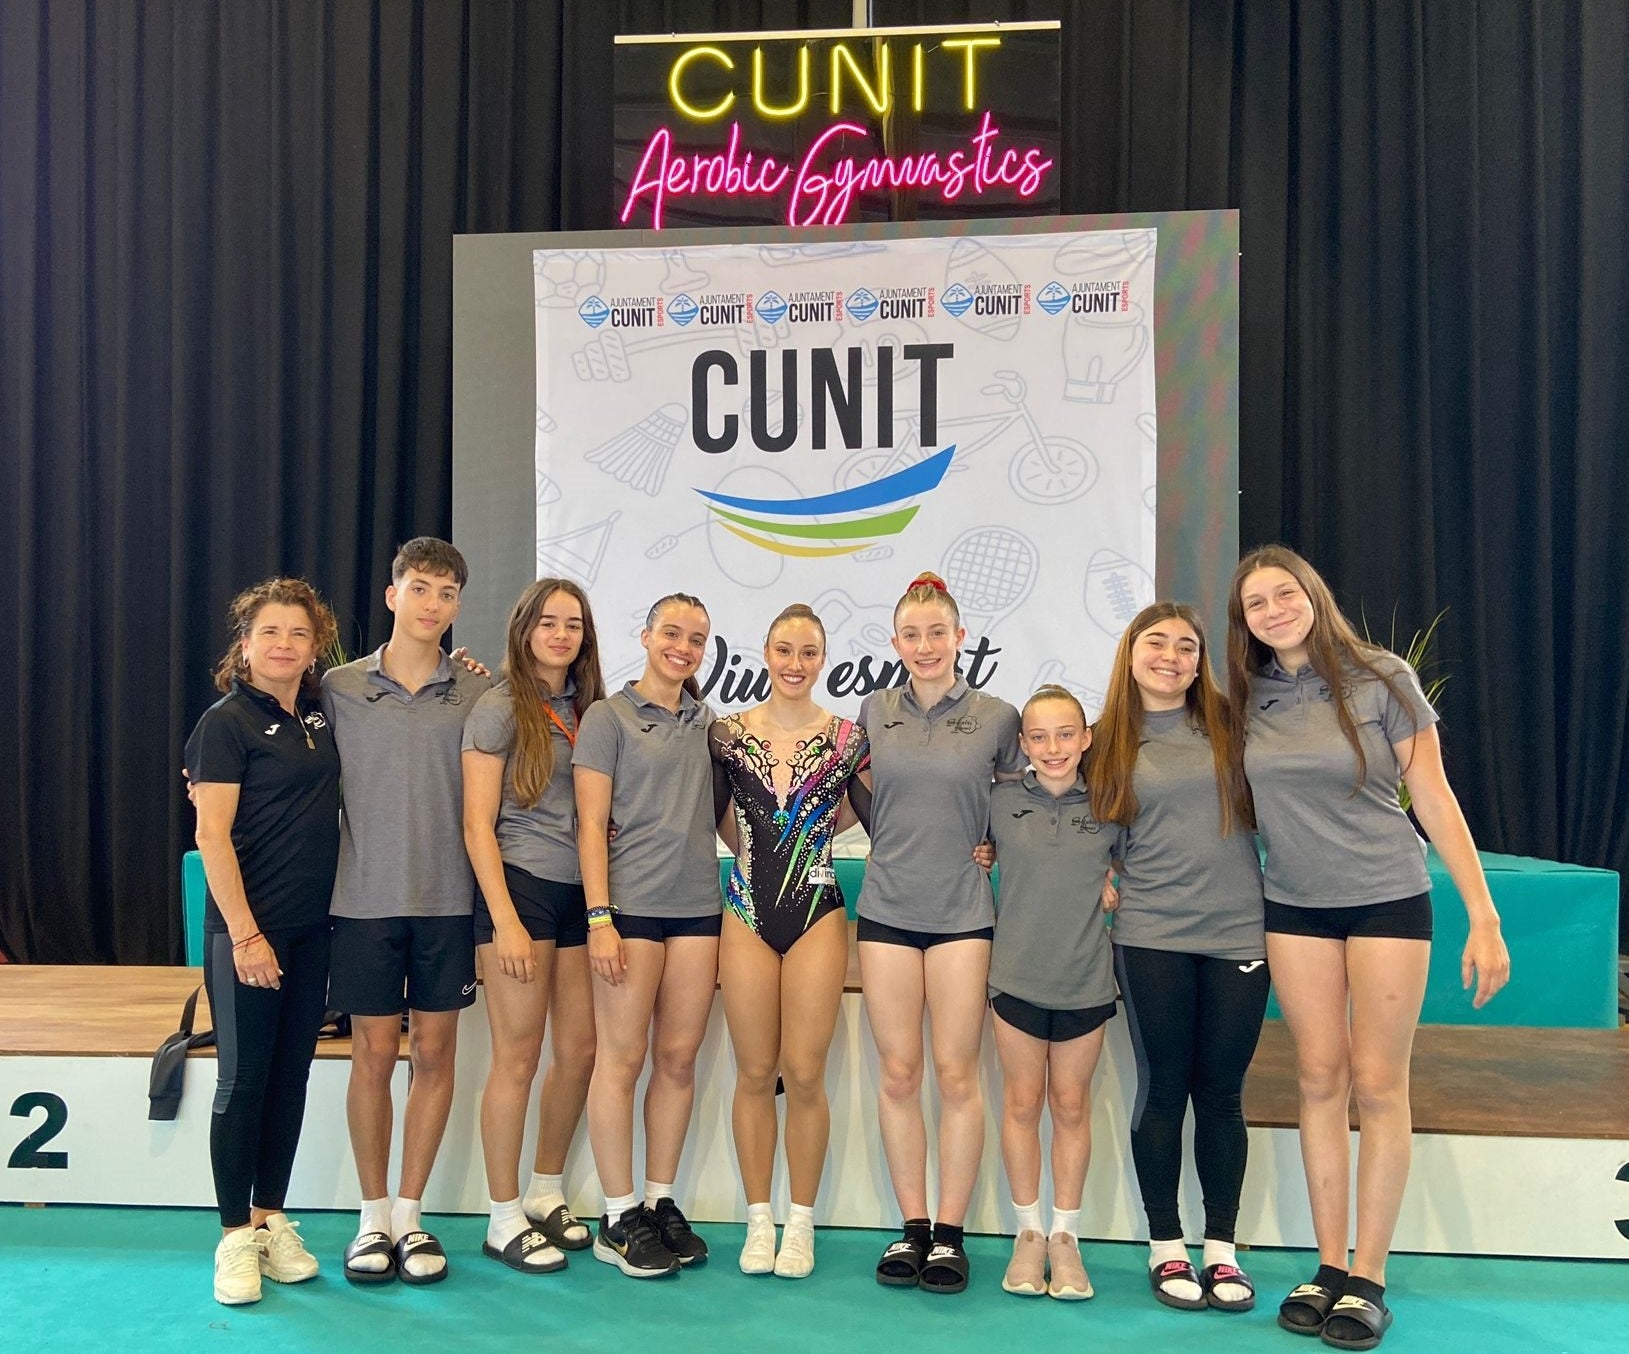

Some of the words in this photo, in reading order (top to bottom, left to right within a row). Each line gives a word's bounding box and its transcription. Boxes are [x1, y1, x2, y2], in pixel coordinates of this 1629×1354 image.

[670, 38, 1001, 118] CUNIT
[620, 120, 791, 231] Aerobic
[789, 110, 1053, 227] Gymnastics
[879, 287, 927, 298] AJUNTAMENT
[974, 284, 1022, 294] AJUNTAMENT
[1072, 281, 1121, 292] AJUNTAMENT
[610, 297, 655, 307] AJUNTAMENT
[700, 294, 745, 304] AJUNTAMENT
[788, 291, 835, 301] AJUNTAMENT
[1072, 292, 1120, 313] CUNIT
[1121, 281, 1129, 311] ESPORTS
[880, 299, 926, 319] CUNIT
[975, 295, 1022, 315] CUNIT
[611, 308, 655, 327] CUNIT
[700, 305, 745, 324] CUNIT
[789, 302, 834, 322] CUNIT
[691, 343, 954, 454] CUNIT
[826, 636, 1002, 698] espt
[7, 1092, 69, 1169] 2
[357, 1233, 383, 1247] NIKE
[407, 1234, 430, 1246] NIKE
[889, 1242, 911, 1251] NIKE
[933, 1246, 955, 1255] NIKE
[1164, 1261, 1187, 1270] NIKE
[1218, 1265, 1237, 1274] NIKE
[1296, 1284, 1322, 1293] NIKE
[1340, 1295, 1366, 1305] NIKE
